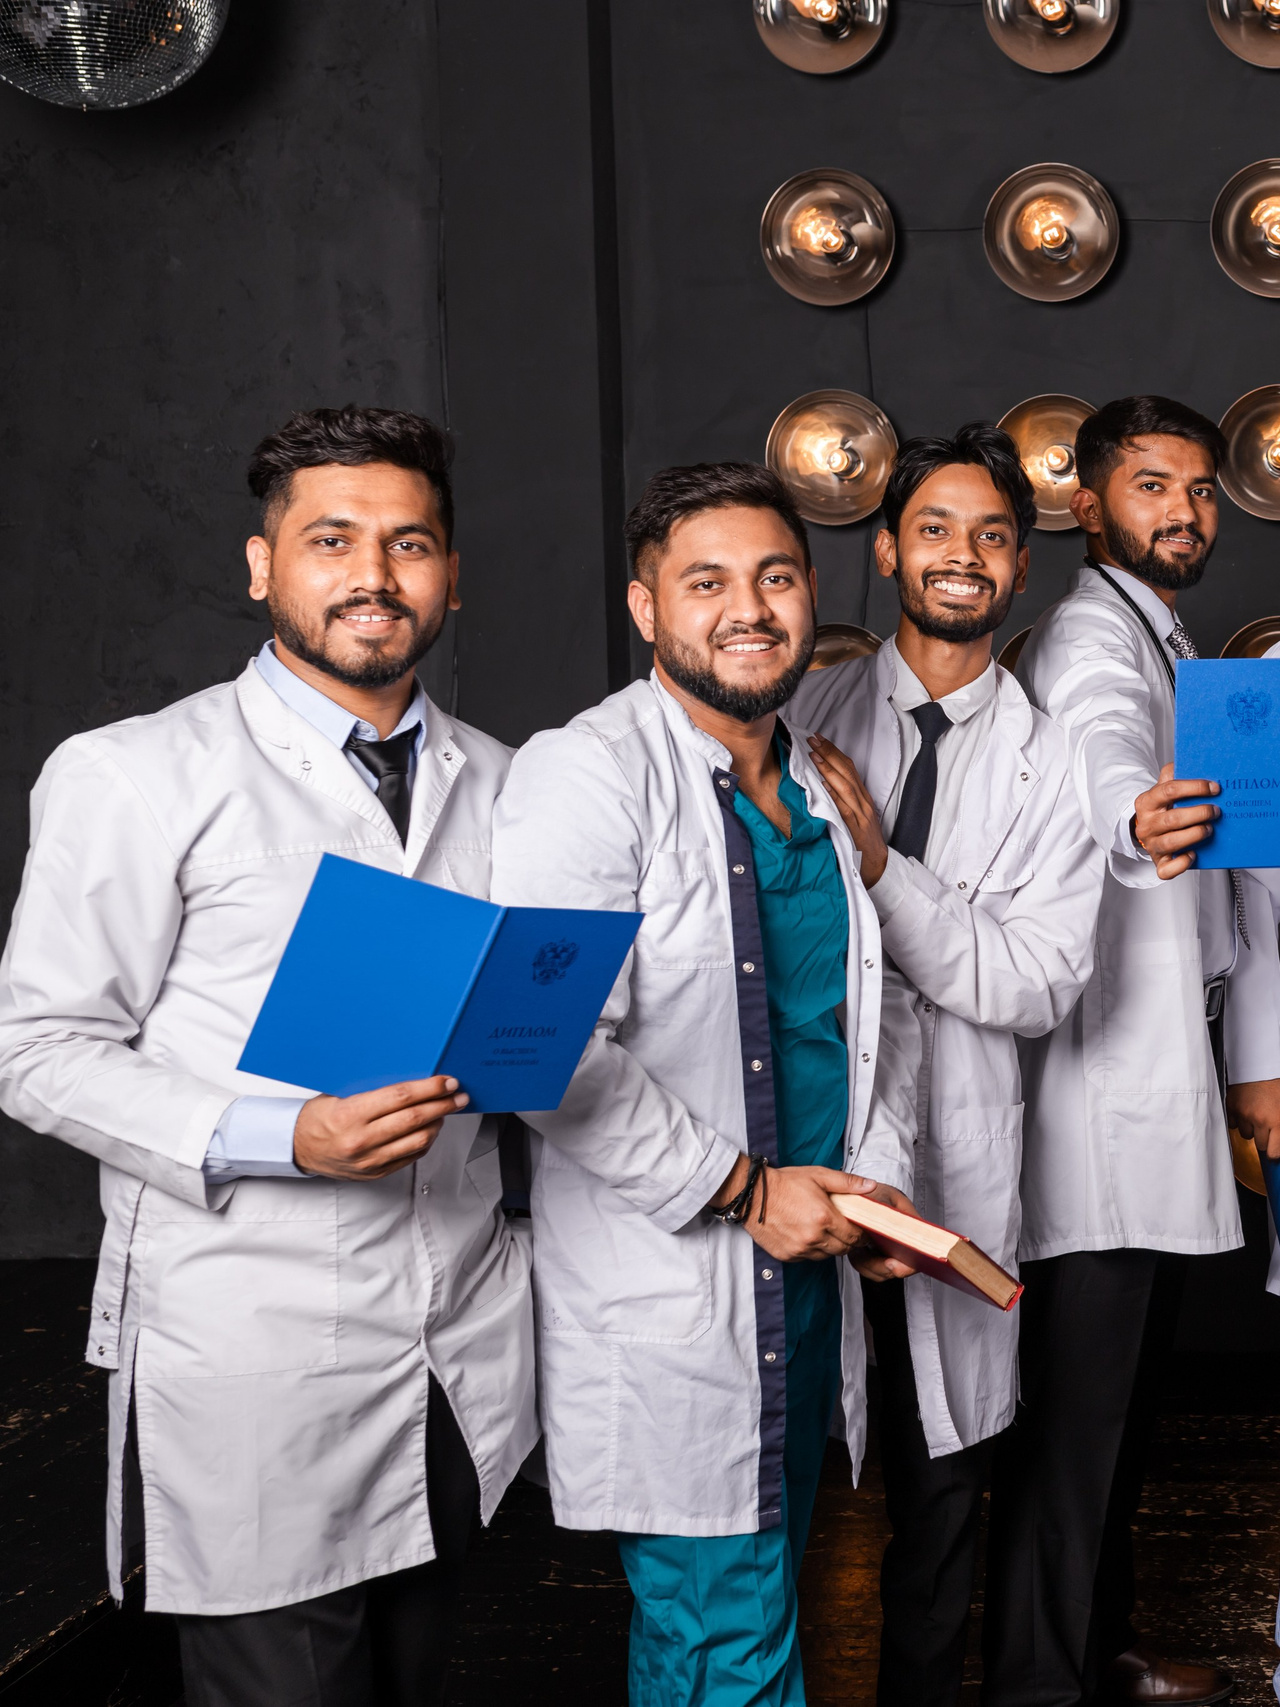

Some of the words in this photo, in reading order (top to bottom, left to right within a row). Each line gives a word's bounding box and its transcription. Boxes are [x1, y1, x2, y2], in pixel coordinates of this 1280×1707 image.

[1225, 800, 1232, 808] О
[1233, 799, 1272, 808] ВЫСШЕМ
[1222, 811, 1279, 820] БРАЗОВАНИИ
[488, 1026, 558, 1039] ДИПЛОМ
